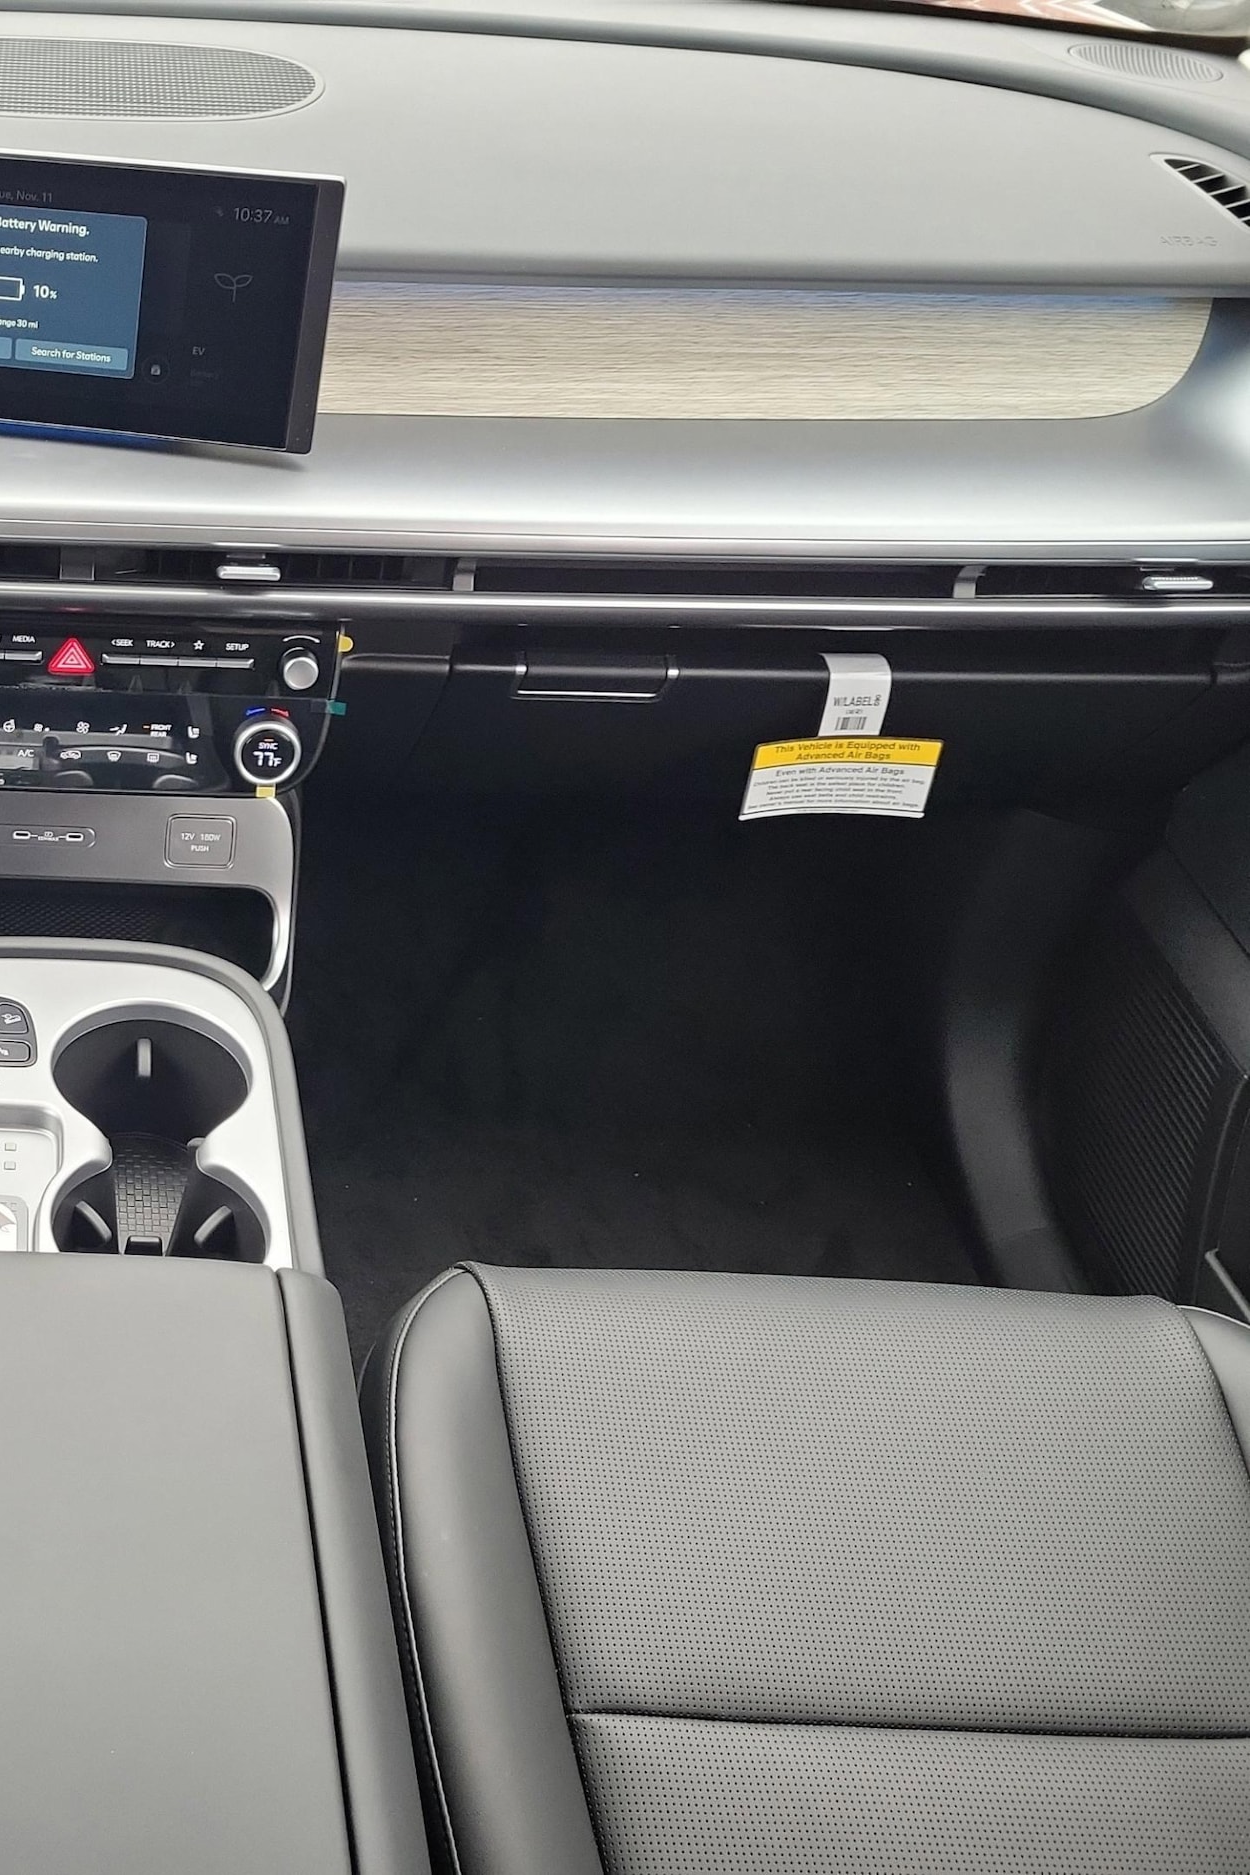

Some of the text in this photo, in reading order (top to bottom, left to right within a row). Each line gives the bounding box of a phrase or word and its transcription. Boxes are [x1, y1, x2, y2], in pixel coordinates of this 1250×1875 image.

[16, 190, 39, 202] Nov.
[42, 192, 52, 203] 11
[233, 207, 273, 224] 10:37
[38, 219, 90, 237] Warning.
[26, 247, 64, 261] charging
[66, 251, 98, 263] station.
[33, 285, 57, 300] 10%
[17, 319, 28, 329] 30
[28, 320, 39, 329] mi
[31, 346, 111, 363] Search for Stations
[192, 346, 206, 356] EV
[12, 635, 36, 643] MEDIA
[225, 643, 250, 651] SETUP
[258, 742, 279, 750] SYNC
[774, 746, 794, 754] This
[798, 743, 832, 752] Vehicle
[846, 741, 896, 751] Equipped
[898, 743, 920, 751] with
[17, 749, 35, 758] A/C
[795, 751, 891, 761] Advanced Air Bags
[776, 769, 797, 777] Even
[819, 766, 863, 774] Advanced
[865, 766, 879, 774] Air
[881, 767, 905, 776] Bags
[181, 832, 196, 841] 12V
[190, 844, 210, 852] PUSH
